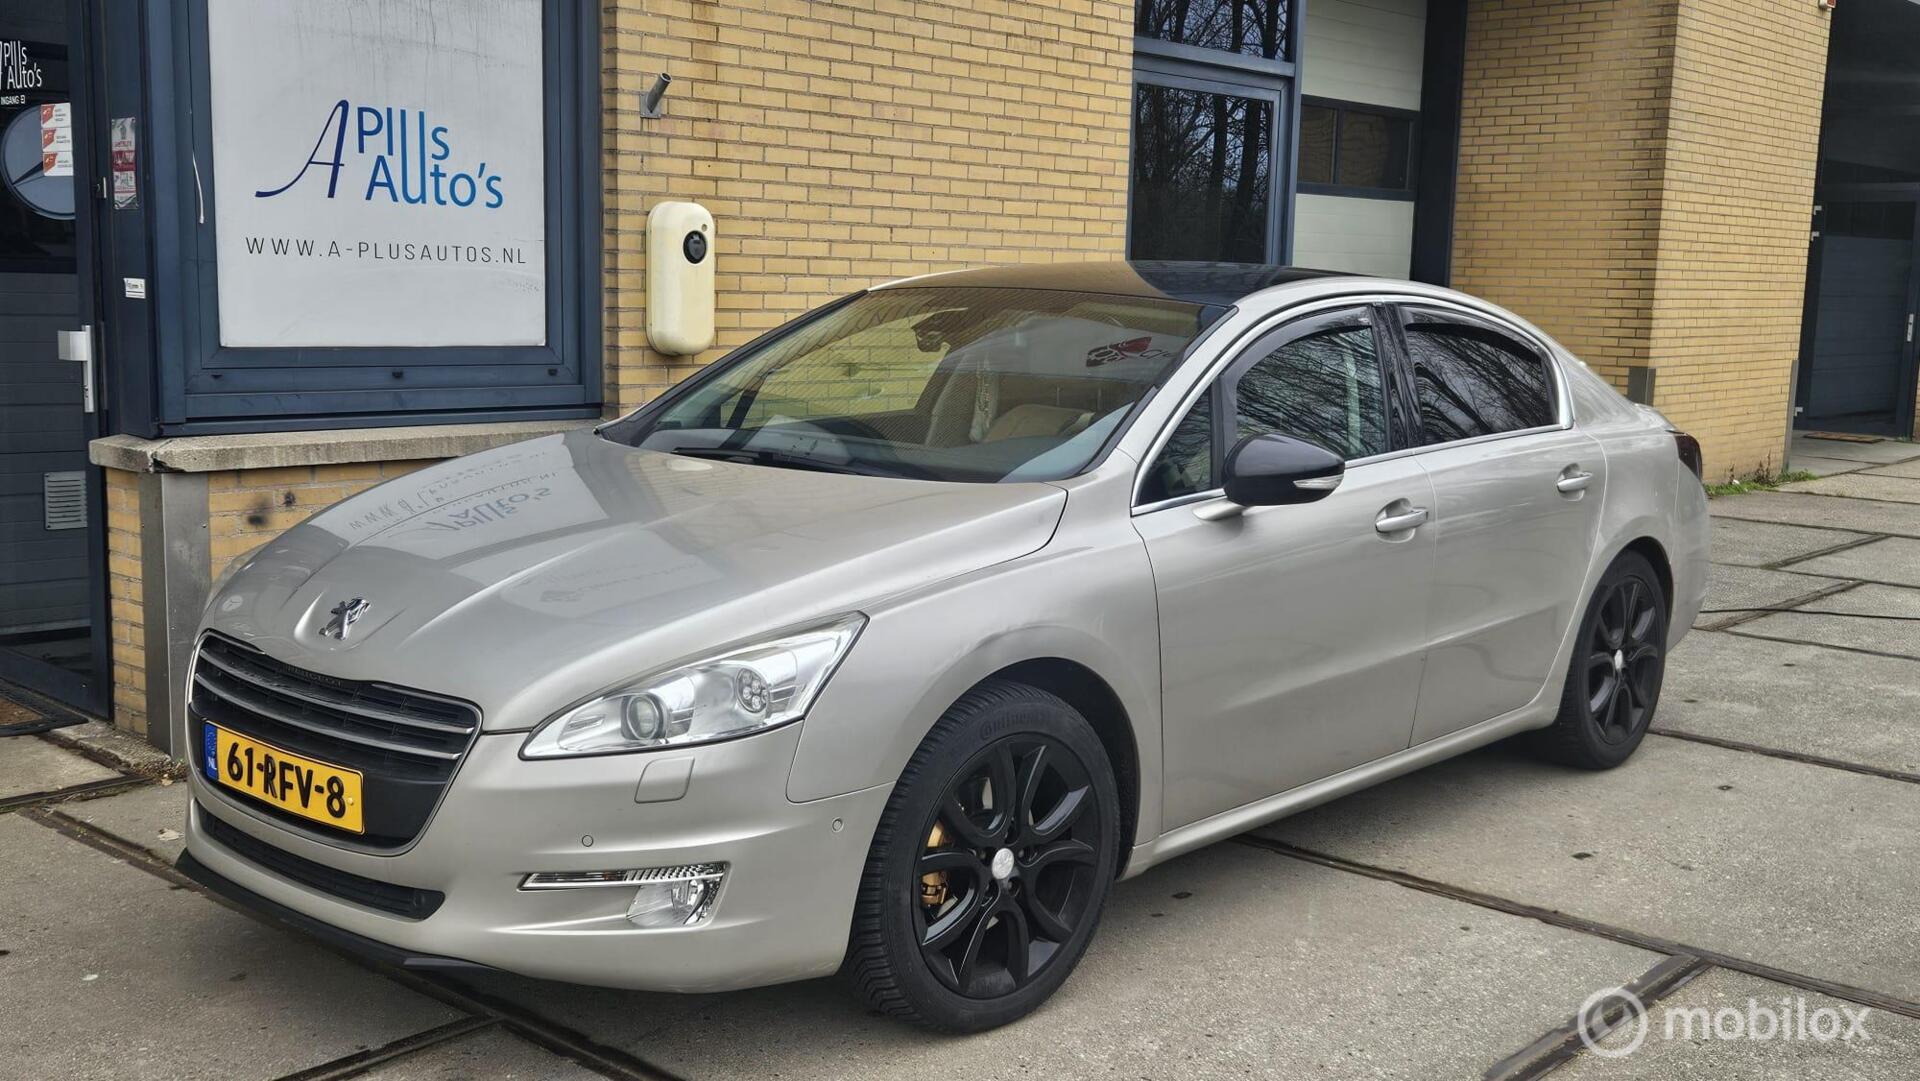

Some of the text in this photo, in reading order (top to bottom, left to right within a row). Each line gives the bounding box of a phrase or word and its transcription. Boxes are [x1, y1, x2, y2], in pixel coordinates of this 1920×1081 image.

[255, 99, 349, 199] A
[245, 236, 527, 265] WWW.A-PLUSAUTOS.NL
[227, 742, 346, 819] 61-RFV-8
